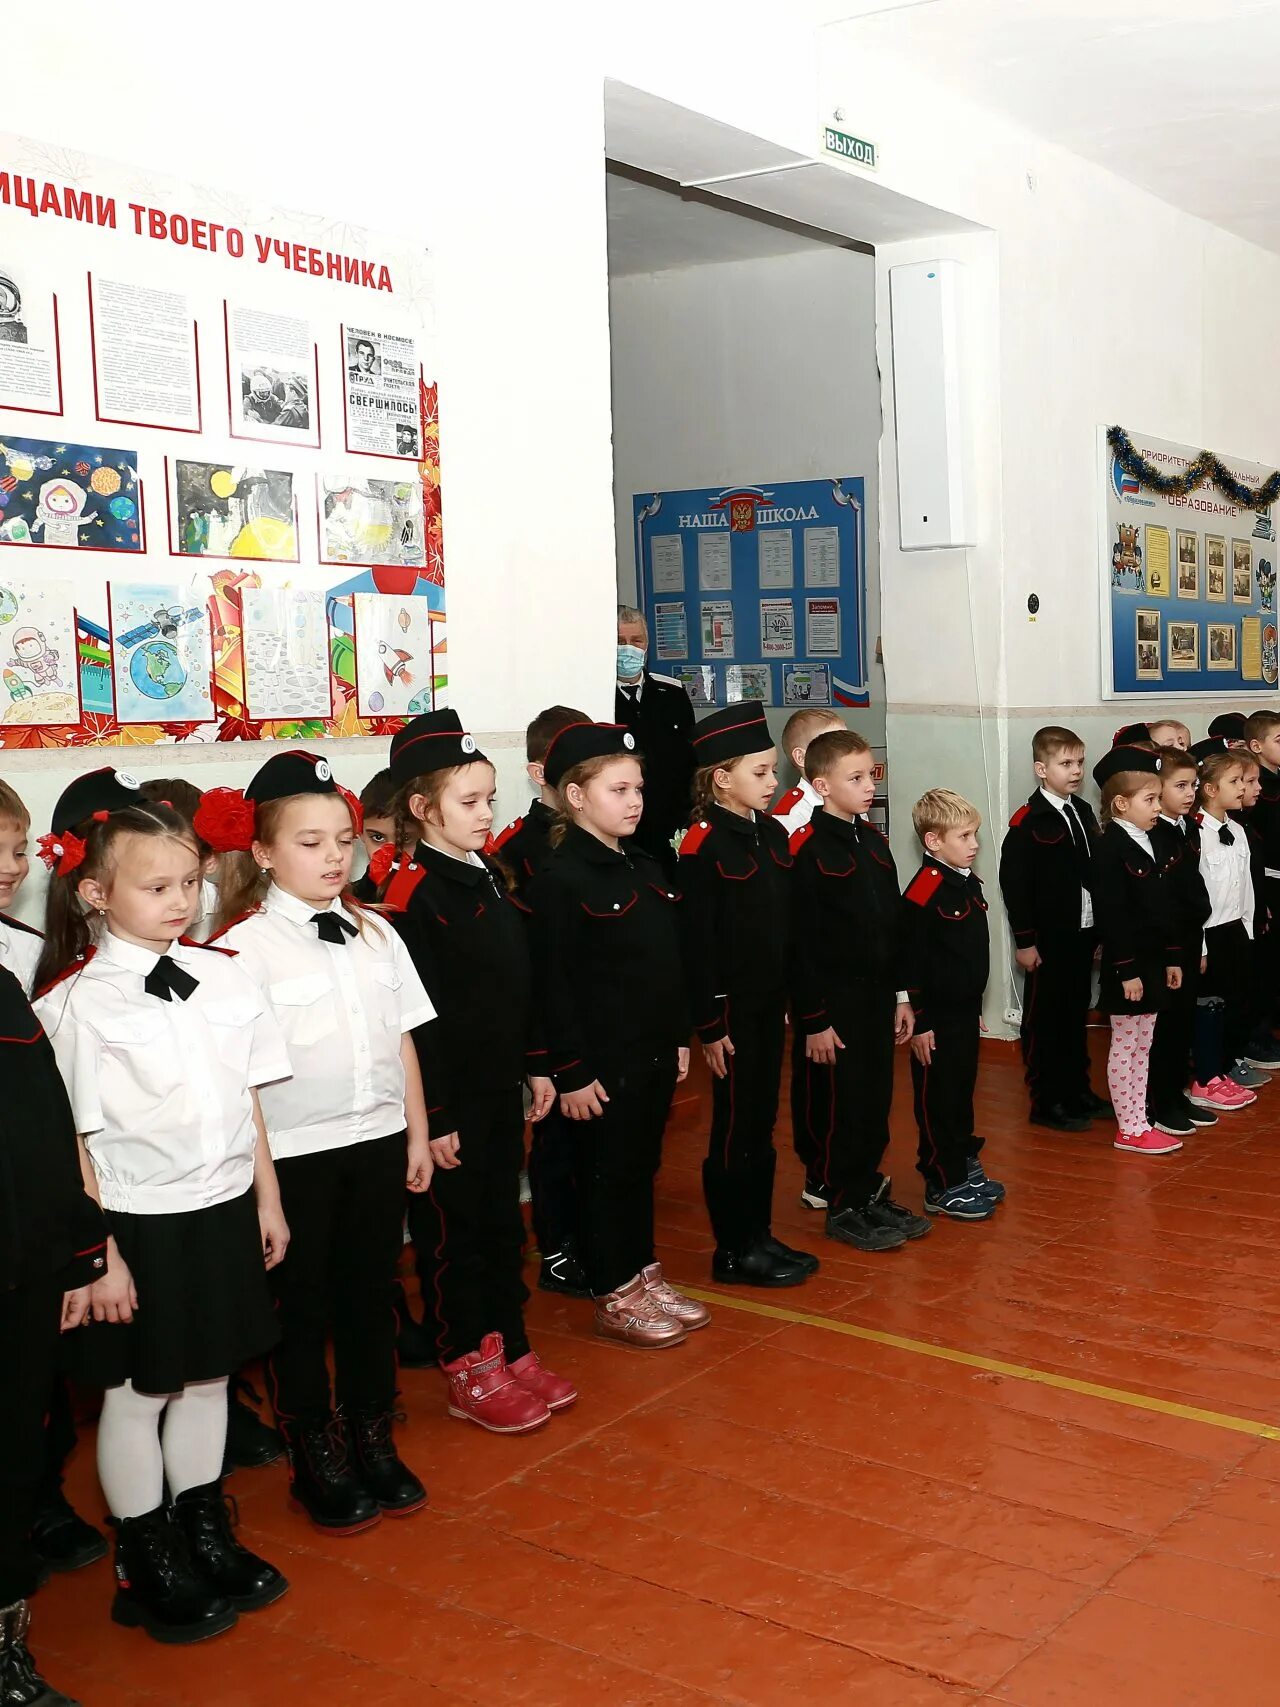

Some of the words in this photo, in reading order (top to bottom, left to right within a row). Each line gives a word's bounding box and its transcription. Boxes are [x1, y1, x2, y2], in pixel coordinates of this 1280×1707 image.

[826, 131, 873, 164] ВЫХОД
[128, 203, 244, 258] ТВОЕГО
[254, 234, 393, 293] УЧЕБНИКА
[347, 327, 376, 337] ЧЕЛОВЕК
[354, 373, 374, 385] ТРУД
[349, 394, 417, 415] СВЕРШИЛОСЬ!
[1141, 449, 1191, 468] ПРИОРИТЕТН
[678, 513, 729, 528] НАША
[756, 506, 820, 525] ШКОЛА
